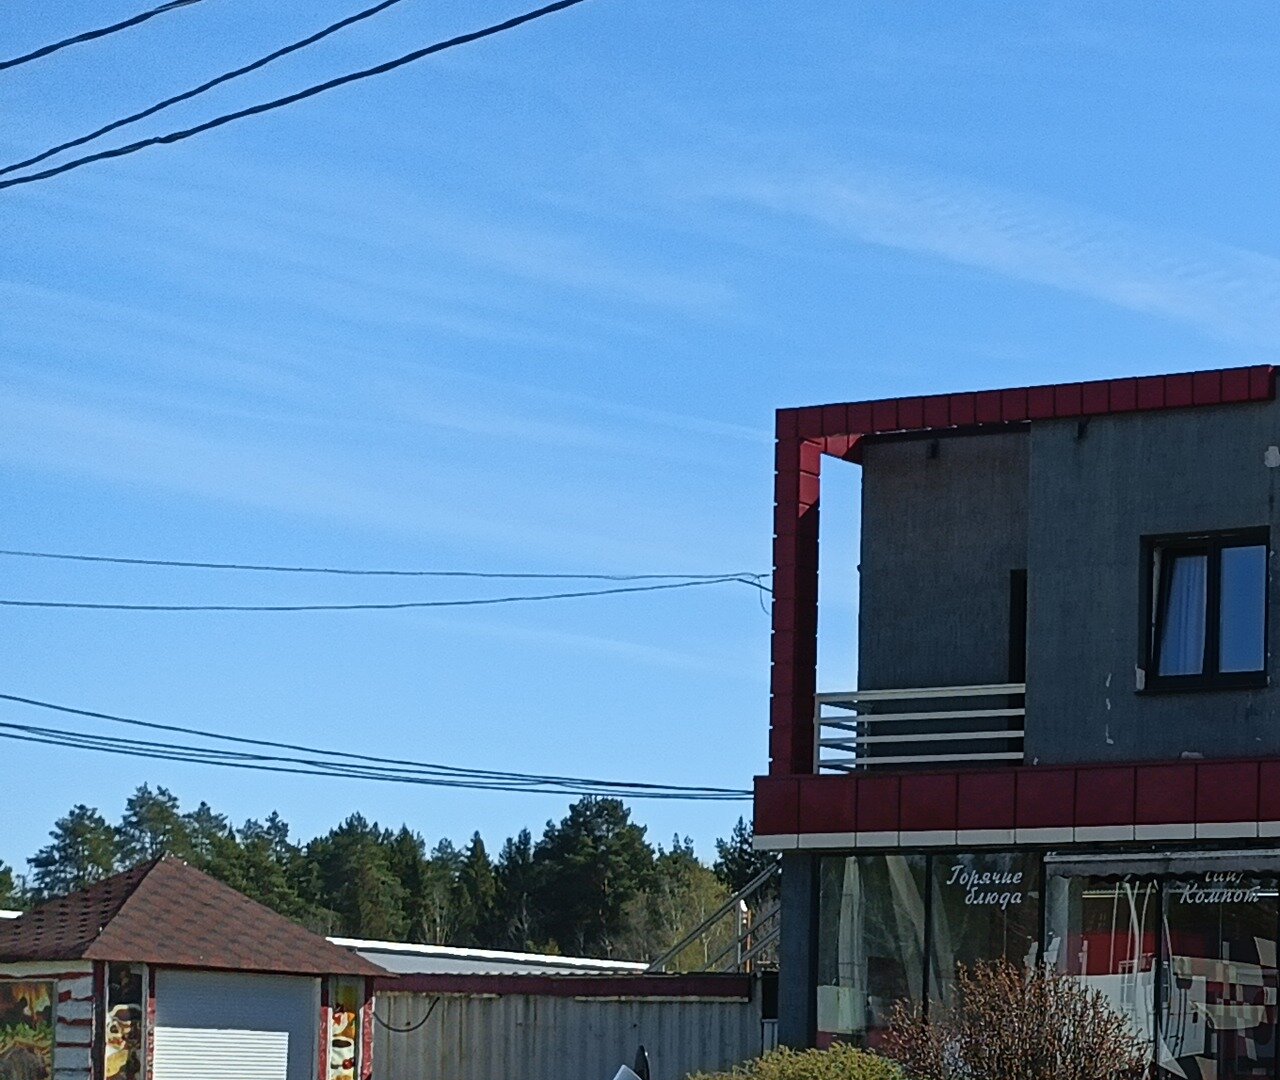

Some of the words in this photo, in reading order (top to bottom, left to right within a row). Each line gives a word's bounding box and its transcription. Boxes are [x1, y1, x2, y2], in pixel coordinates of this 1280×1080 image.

[946, 865, 1022, 892] Горячие
[965, 887, 1022, 910] блюда
[1180, 881, 1261, 904] Компот
